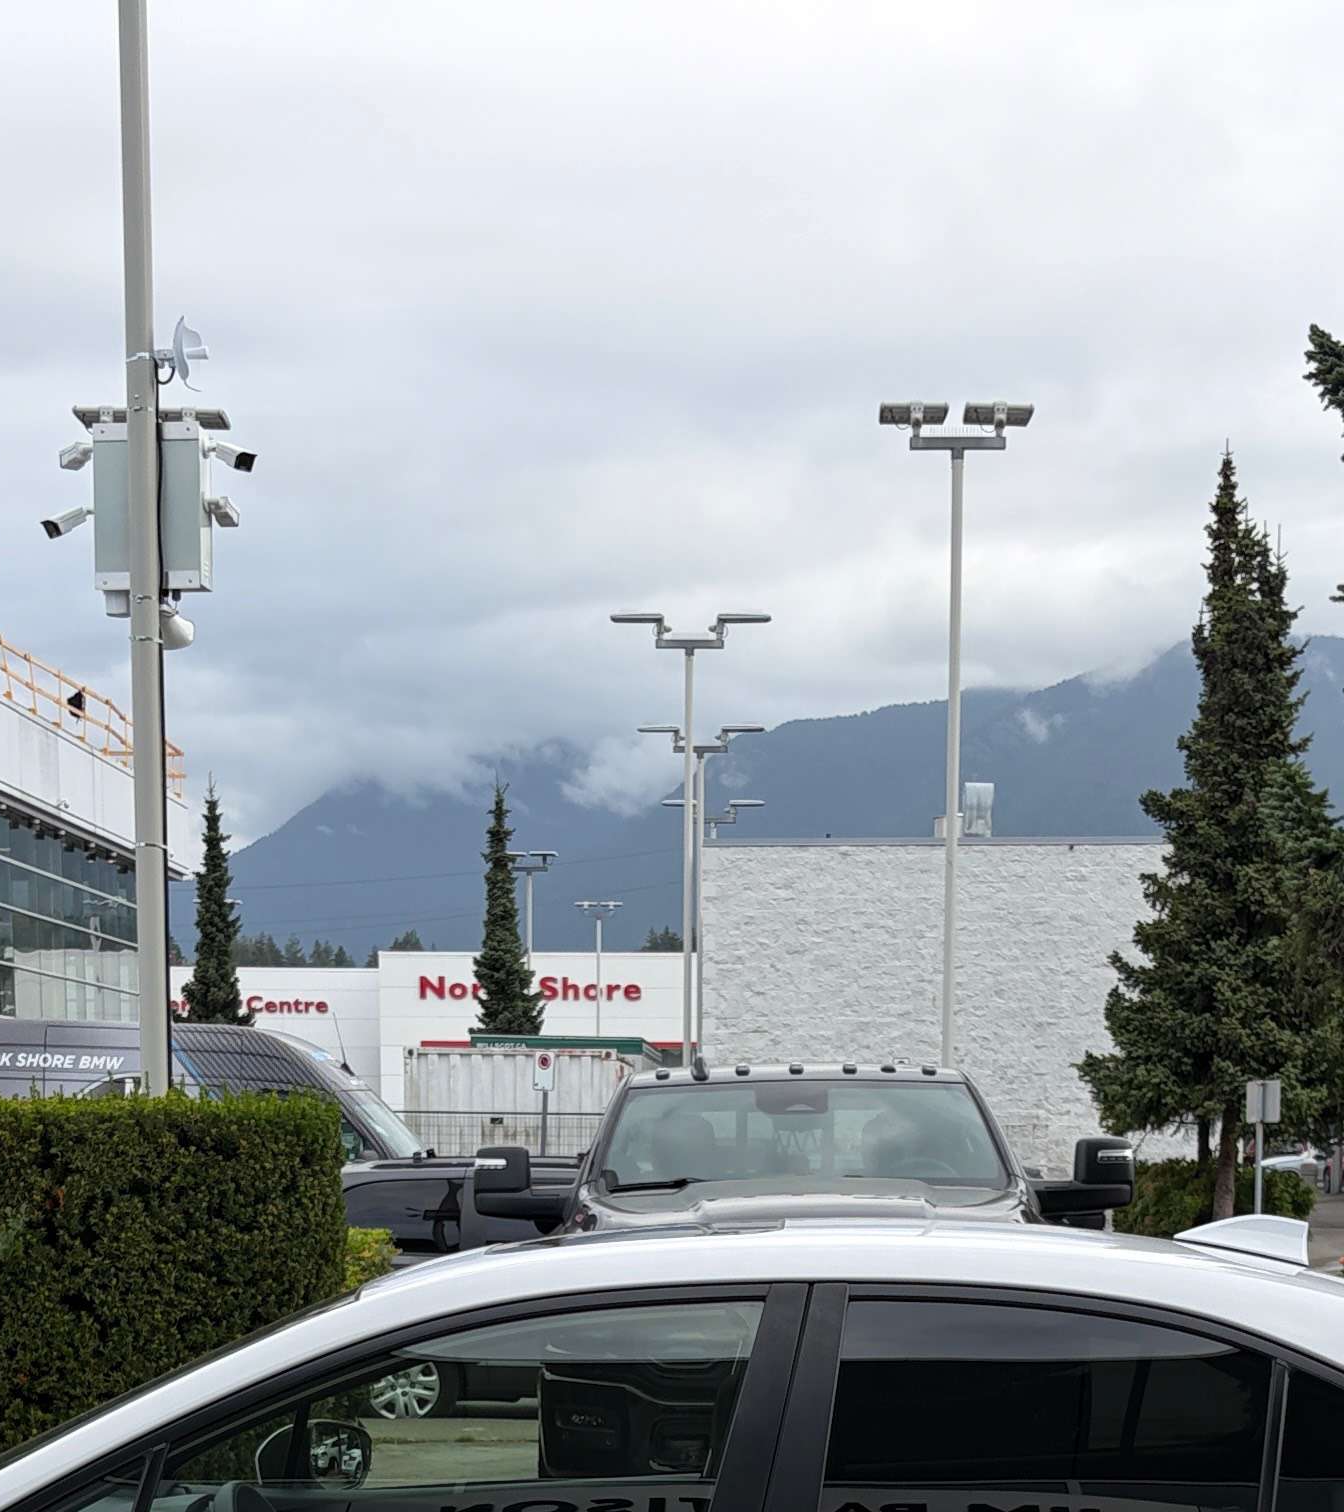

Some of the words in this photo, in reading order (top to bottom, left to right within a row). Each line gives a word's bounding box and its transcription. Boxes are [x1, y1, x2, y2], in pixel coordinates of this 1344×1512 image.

[539, 977, 642, 1001] Shore
[246, 996, 329, 1013] Centre
[16, 1053, 74, 1068] SHORE
[79, 1055, 124, 1070] BMW
